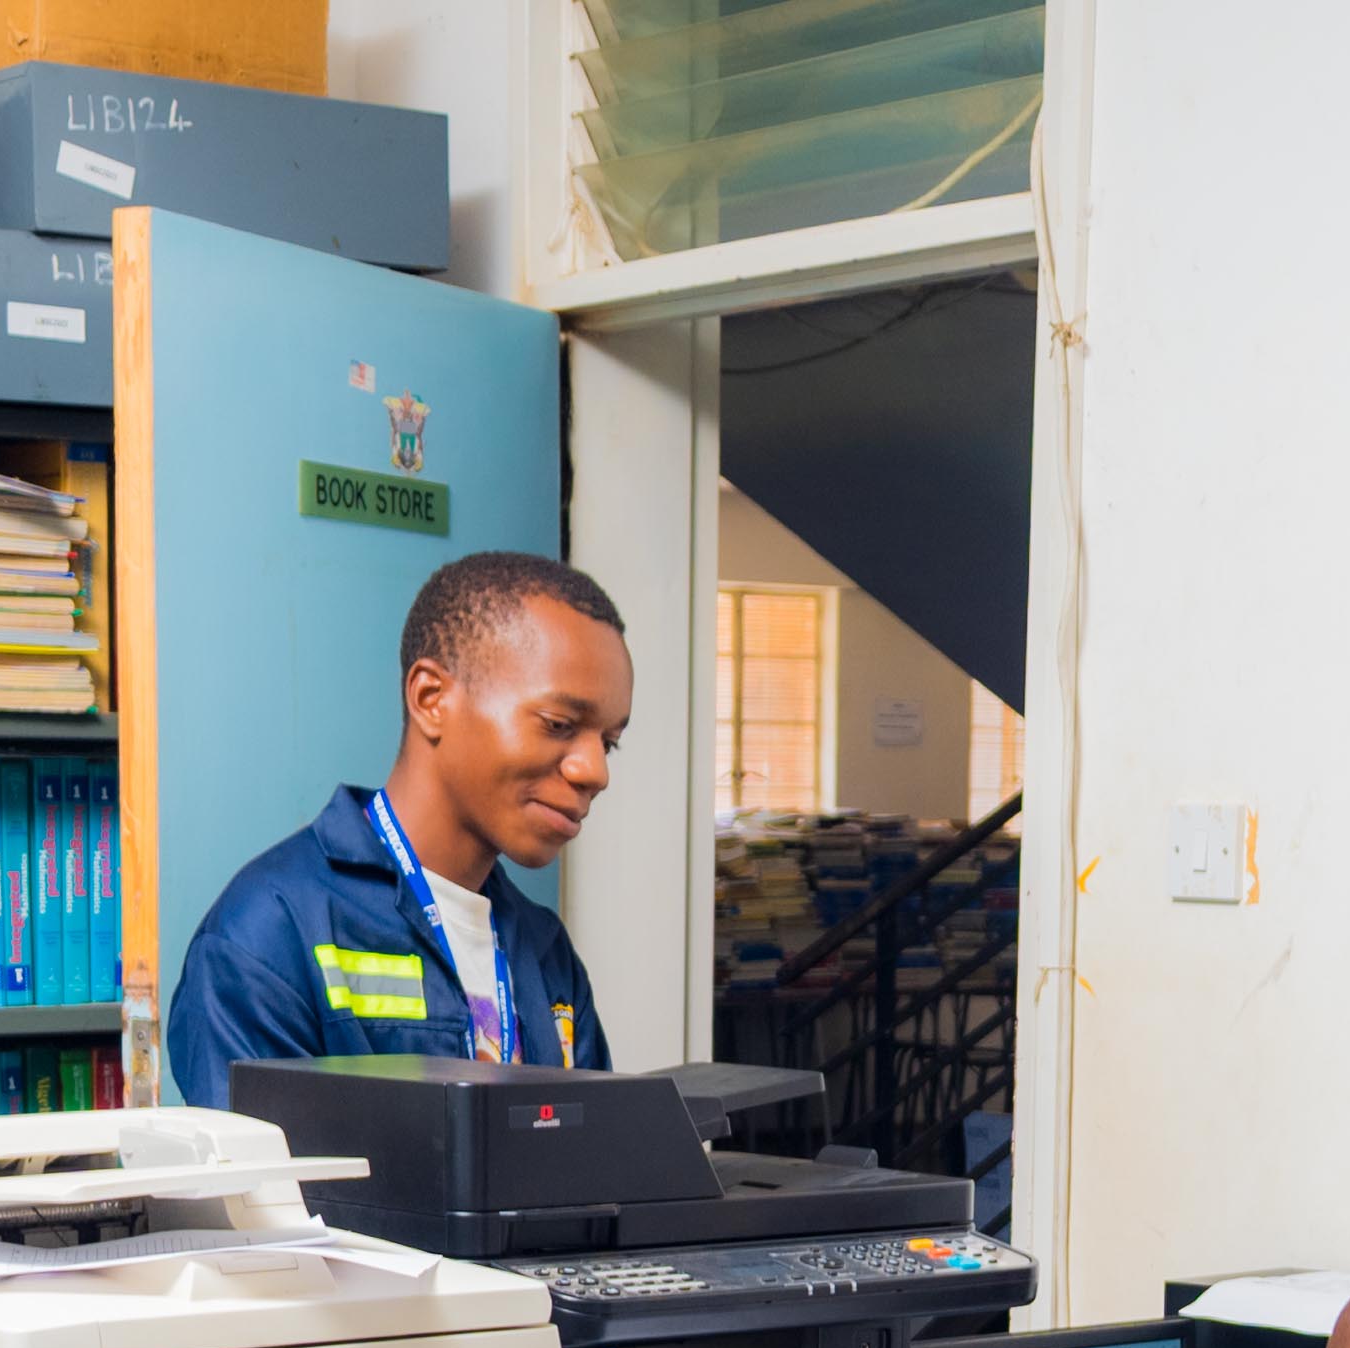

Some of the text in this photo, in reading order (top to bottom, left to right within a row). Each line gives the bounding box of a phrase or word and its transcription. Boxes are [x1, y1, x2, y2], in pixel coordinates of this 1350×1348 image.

[67, 94, 194, 133] LIB124
[51, 253, 114, 285] LIB
[316, 474, 435, 522] BOOK STORE
[42, 804, 60, 897] Integrated
[70, 804, 87, 897] Integrated
[97, 805, 114, 897] Integrated
